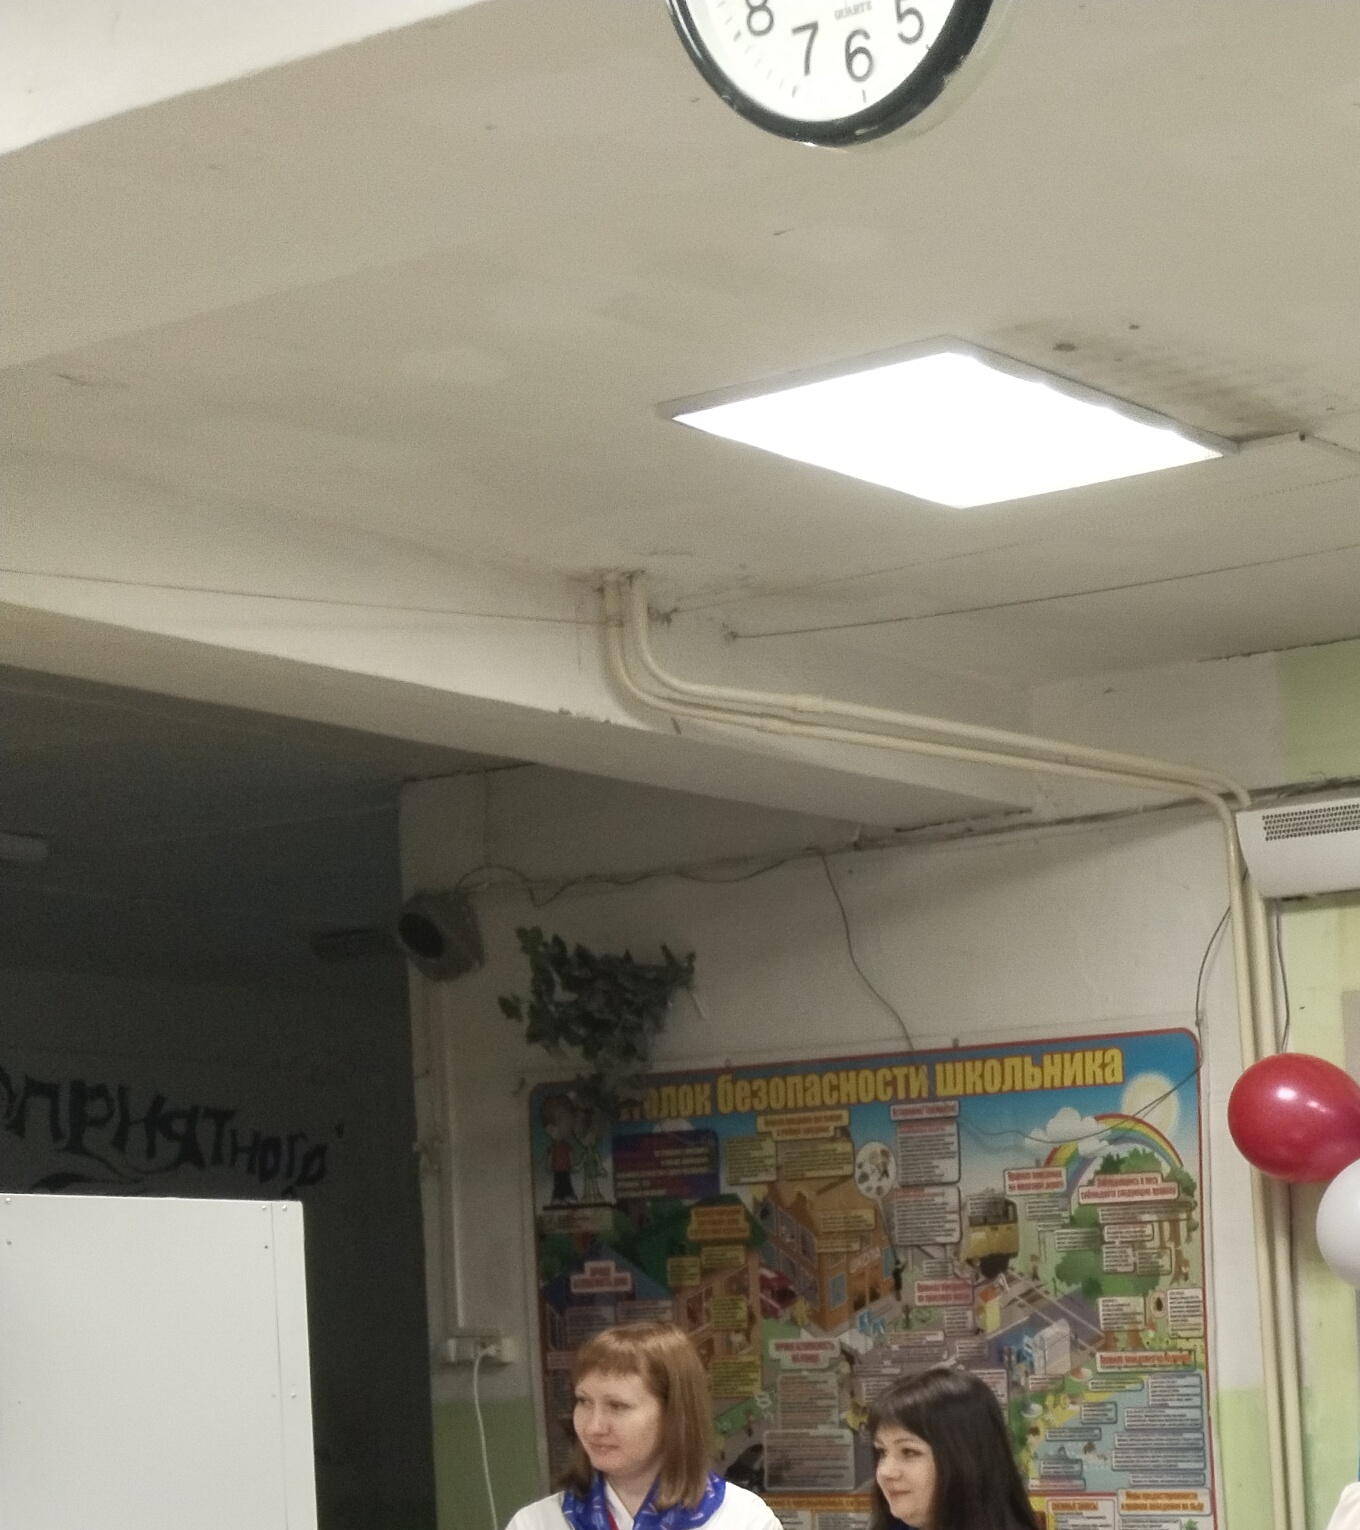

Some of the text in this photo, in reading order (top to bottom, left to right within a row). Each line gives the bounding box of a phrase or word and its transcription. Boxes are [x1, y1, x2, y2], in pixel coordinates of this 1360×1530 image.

[791, 20, 819, 77] 7
[844, 28, 874, 83] 6
[617, 1047, 1125, 1122] олок безопасности школьника
